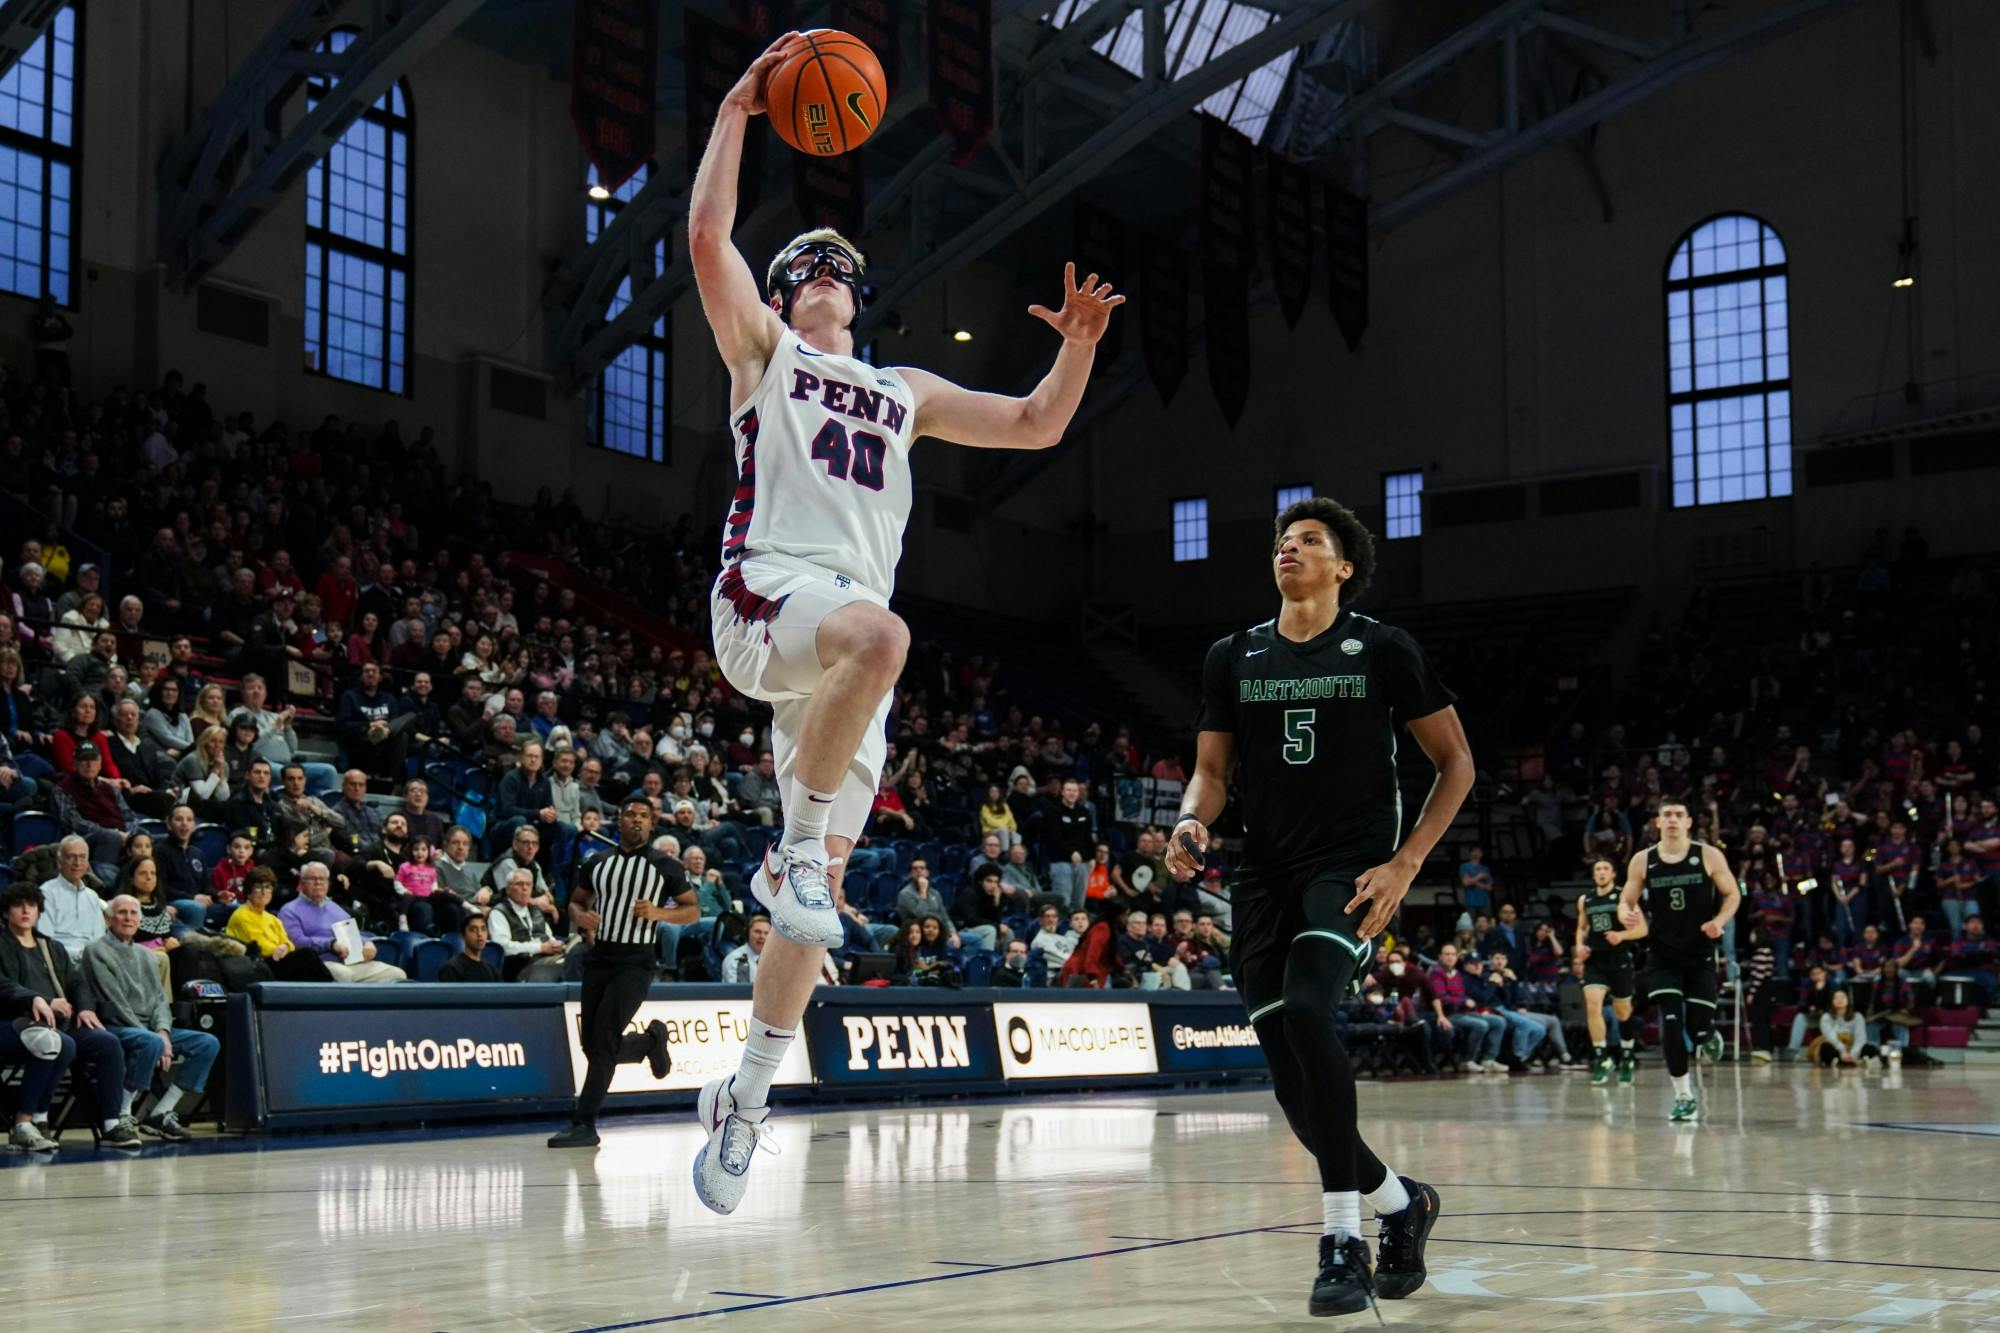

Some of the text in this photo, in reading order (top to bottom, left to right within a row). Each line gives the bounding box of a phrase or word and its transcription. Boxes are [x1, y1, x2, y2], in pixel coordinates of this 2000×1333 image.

[808, 103, 835, 153] ELITE
[790, 368, 907, 436] PENN
[811, 417, 887, 492] 40
[1240, 675, 1366, 702] DARTMOUTH
[1283, 708, 1316, 765] 5
[1670, 887, 1686, 911] 3
[1591, 913, 1612, 931] 20
[319, 1038, 525, 1078] #FightOnPenn
[842, 1015, 970, 1070] PENN
[1039, 1026, 1148, 1051] MACQUARIE
